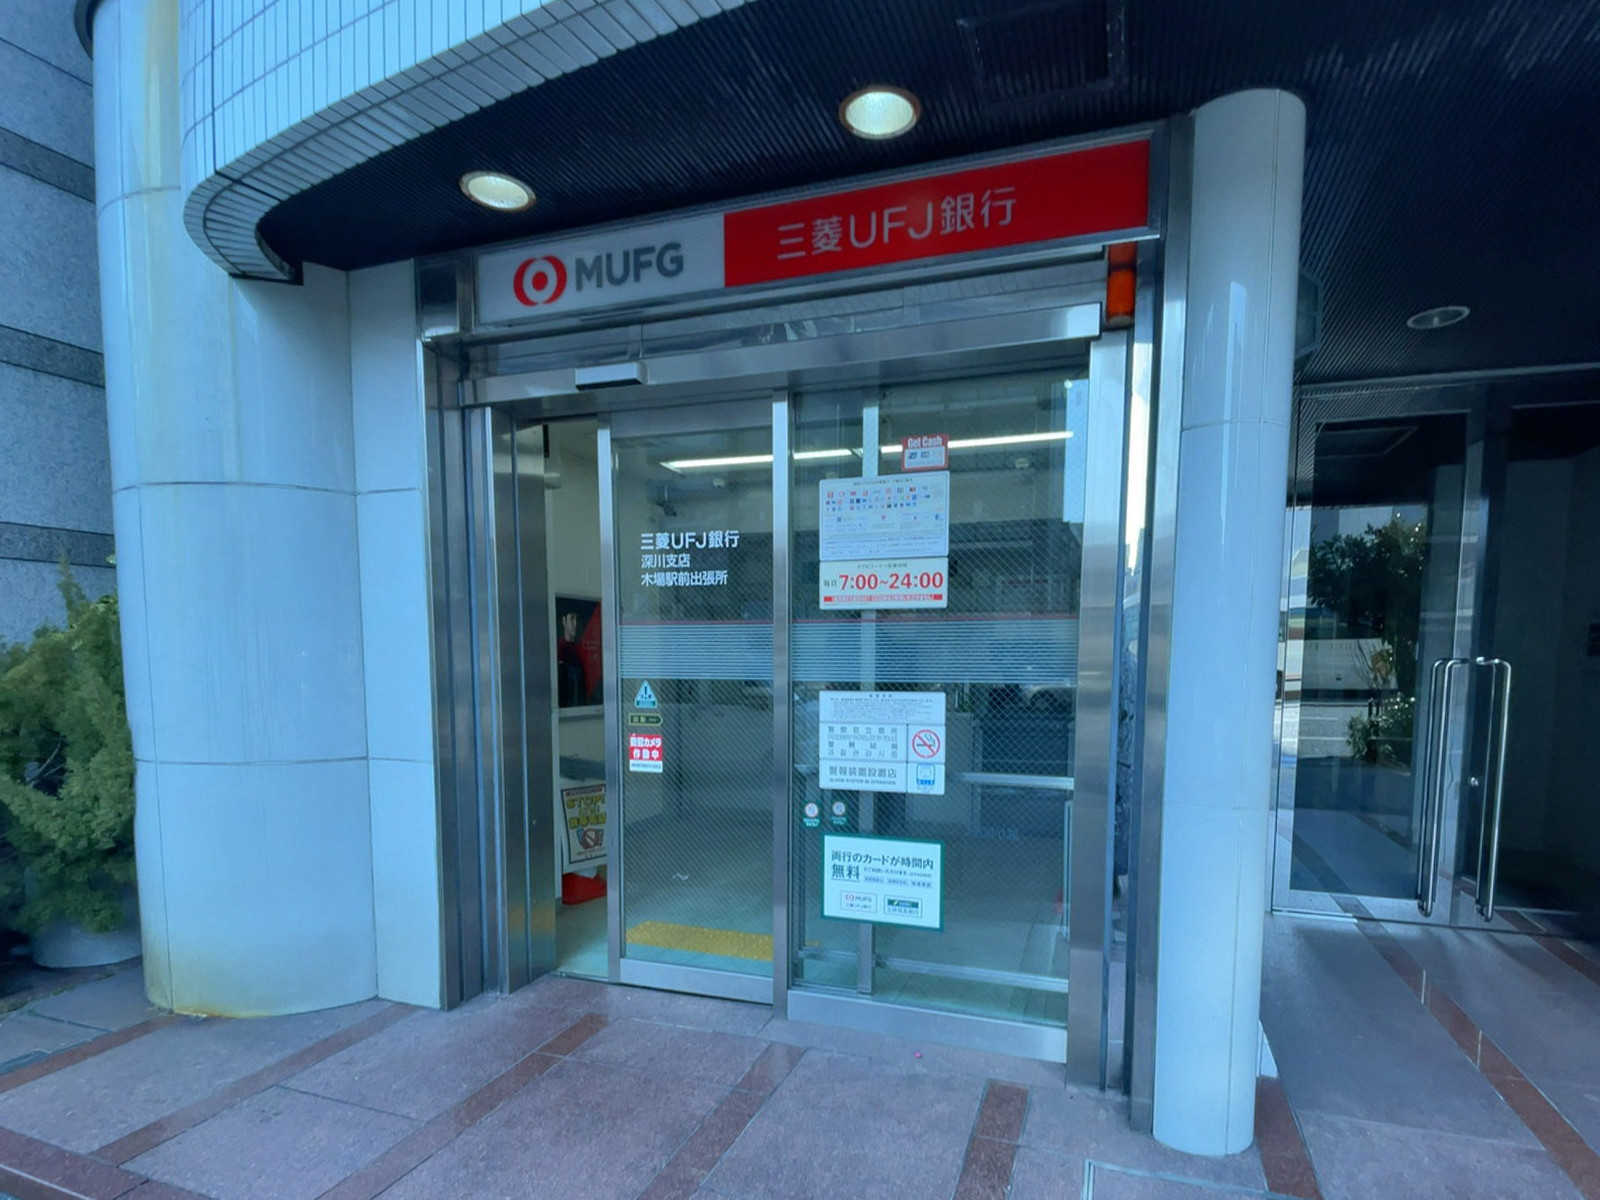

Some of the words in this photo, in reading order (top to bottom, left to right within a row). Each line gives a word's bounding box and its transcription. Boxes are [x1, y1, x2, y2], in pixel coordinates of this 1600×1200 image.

[777, 186, 1017, 260] 三菱UFJ銀行
[575, 242, 684, 292] MUFG
[640, 530, 740, 550] 三菱UFJ銀行
[641, 553, 691, 569] 深川支店
[641, 570, 728, 587] 木場駅前出張所
[831, 850, 934, 870] 両行のカードが時間内
[832, 863, 860, 879] 無料
